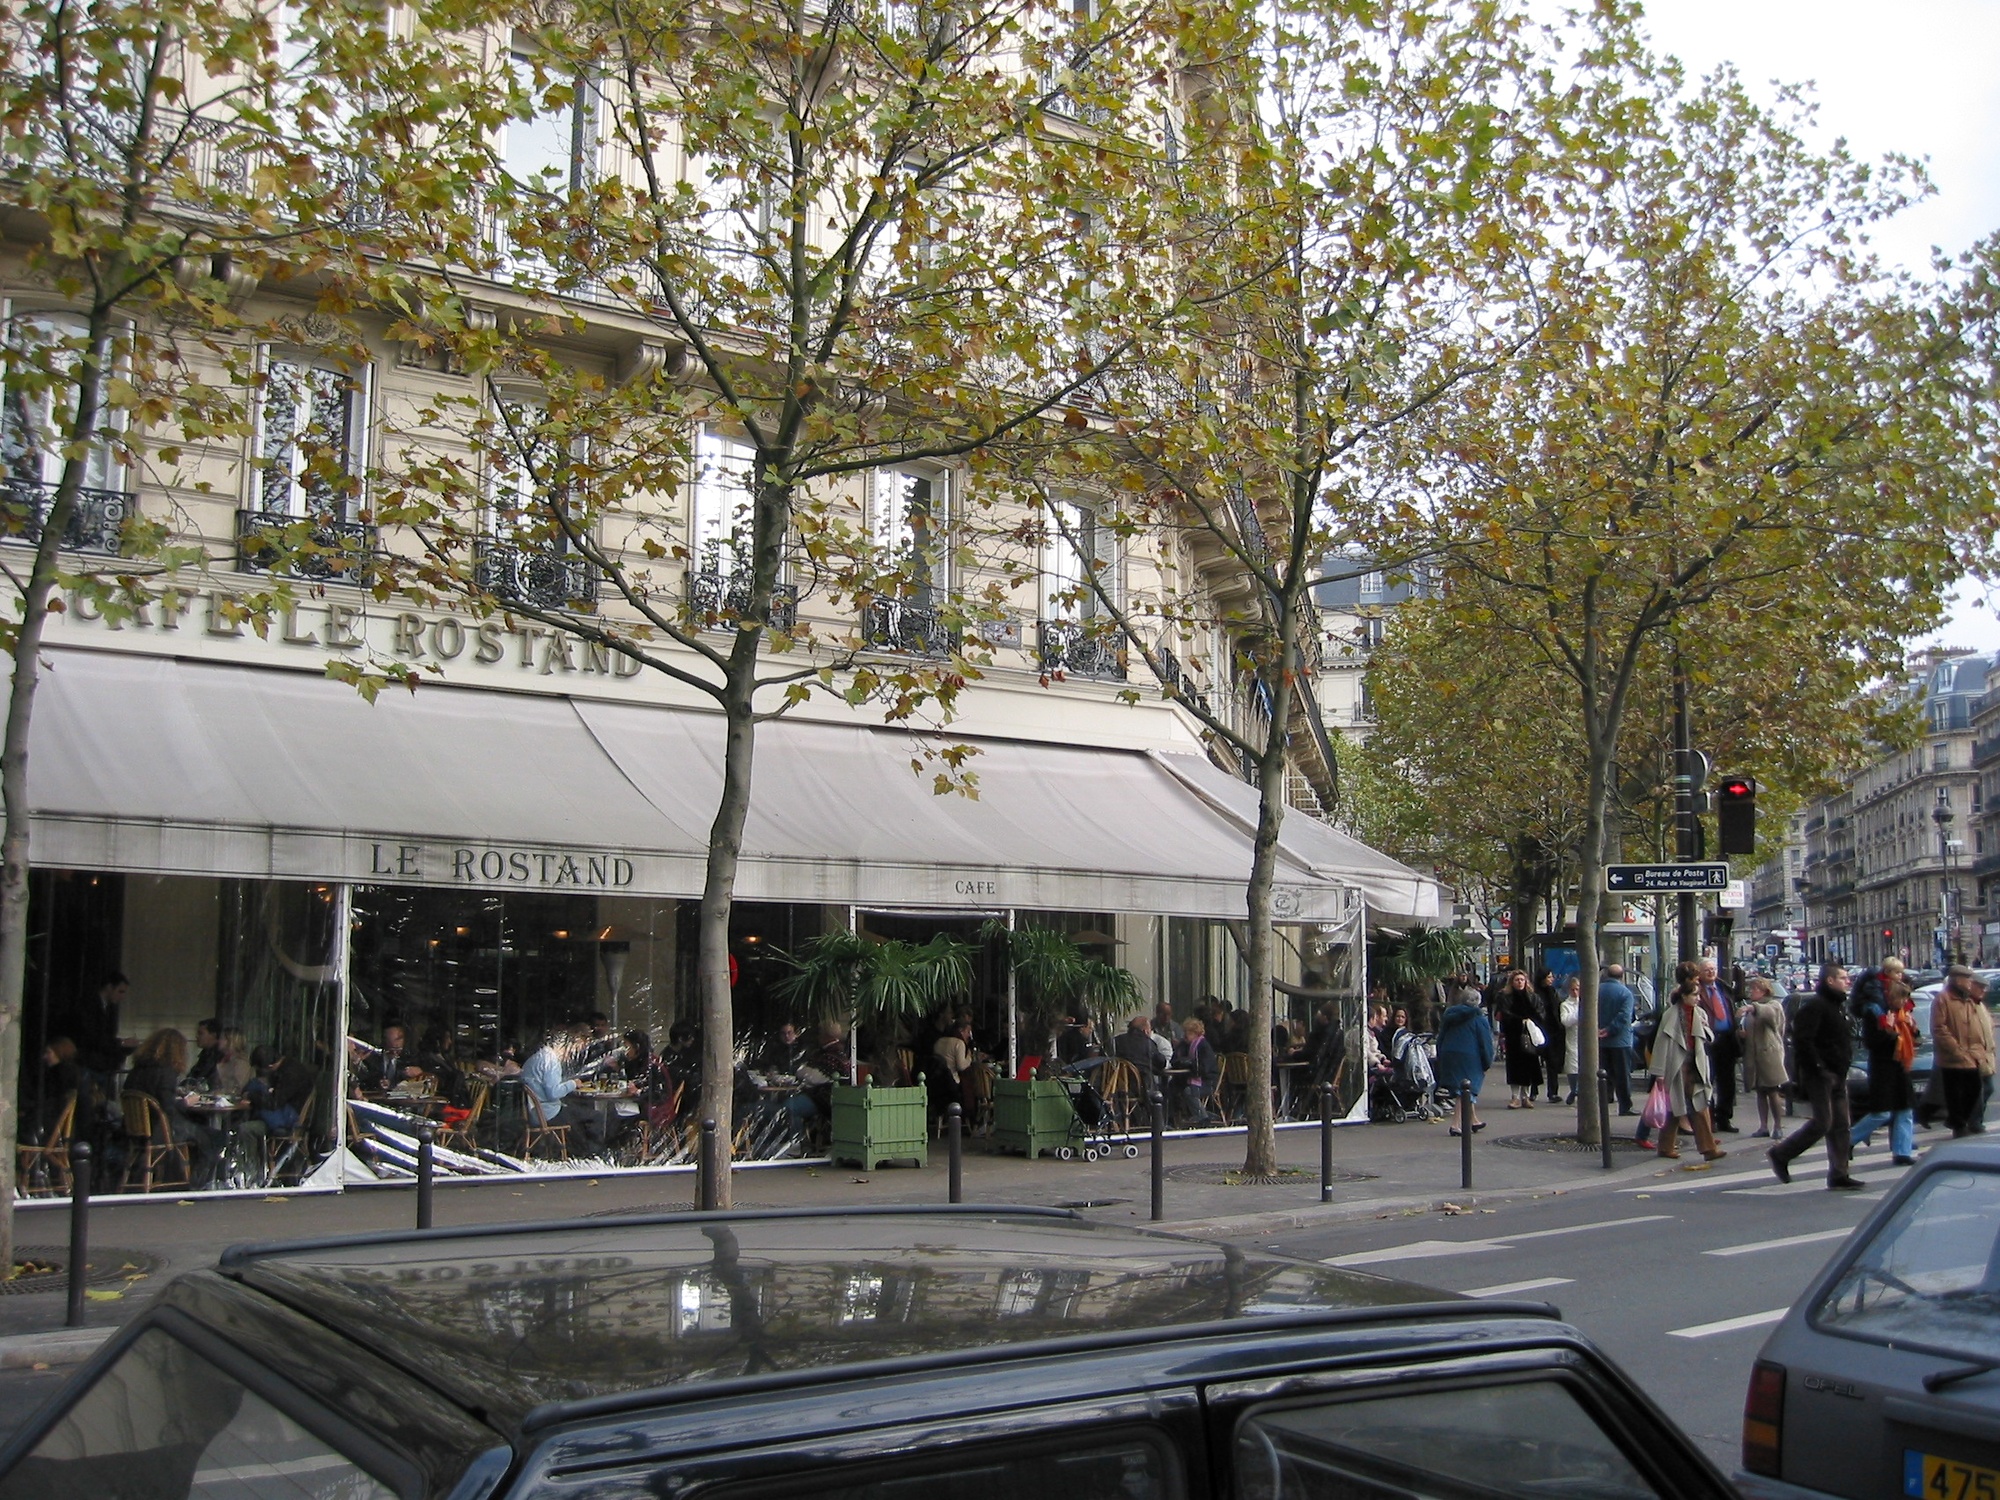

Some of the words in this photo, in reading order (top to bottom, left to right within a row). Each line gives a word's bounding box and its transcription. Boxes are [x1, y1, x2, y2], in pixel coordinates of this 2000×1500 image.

[283, 600, 365, 649] LE
[396, 612, 644, 679] ROSTAND
[371, 844, 421, 876] LE
[452, 849, 634, 887] ROSTAND
[1645, 870, 1670, 878] Bureau
[1683, 869, 1704, 877] Poste
[955, 880, 996, 895] CAFE
[1804, 1376, 1864, 1400] OPEL
